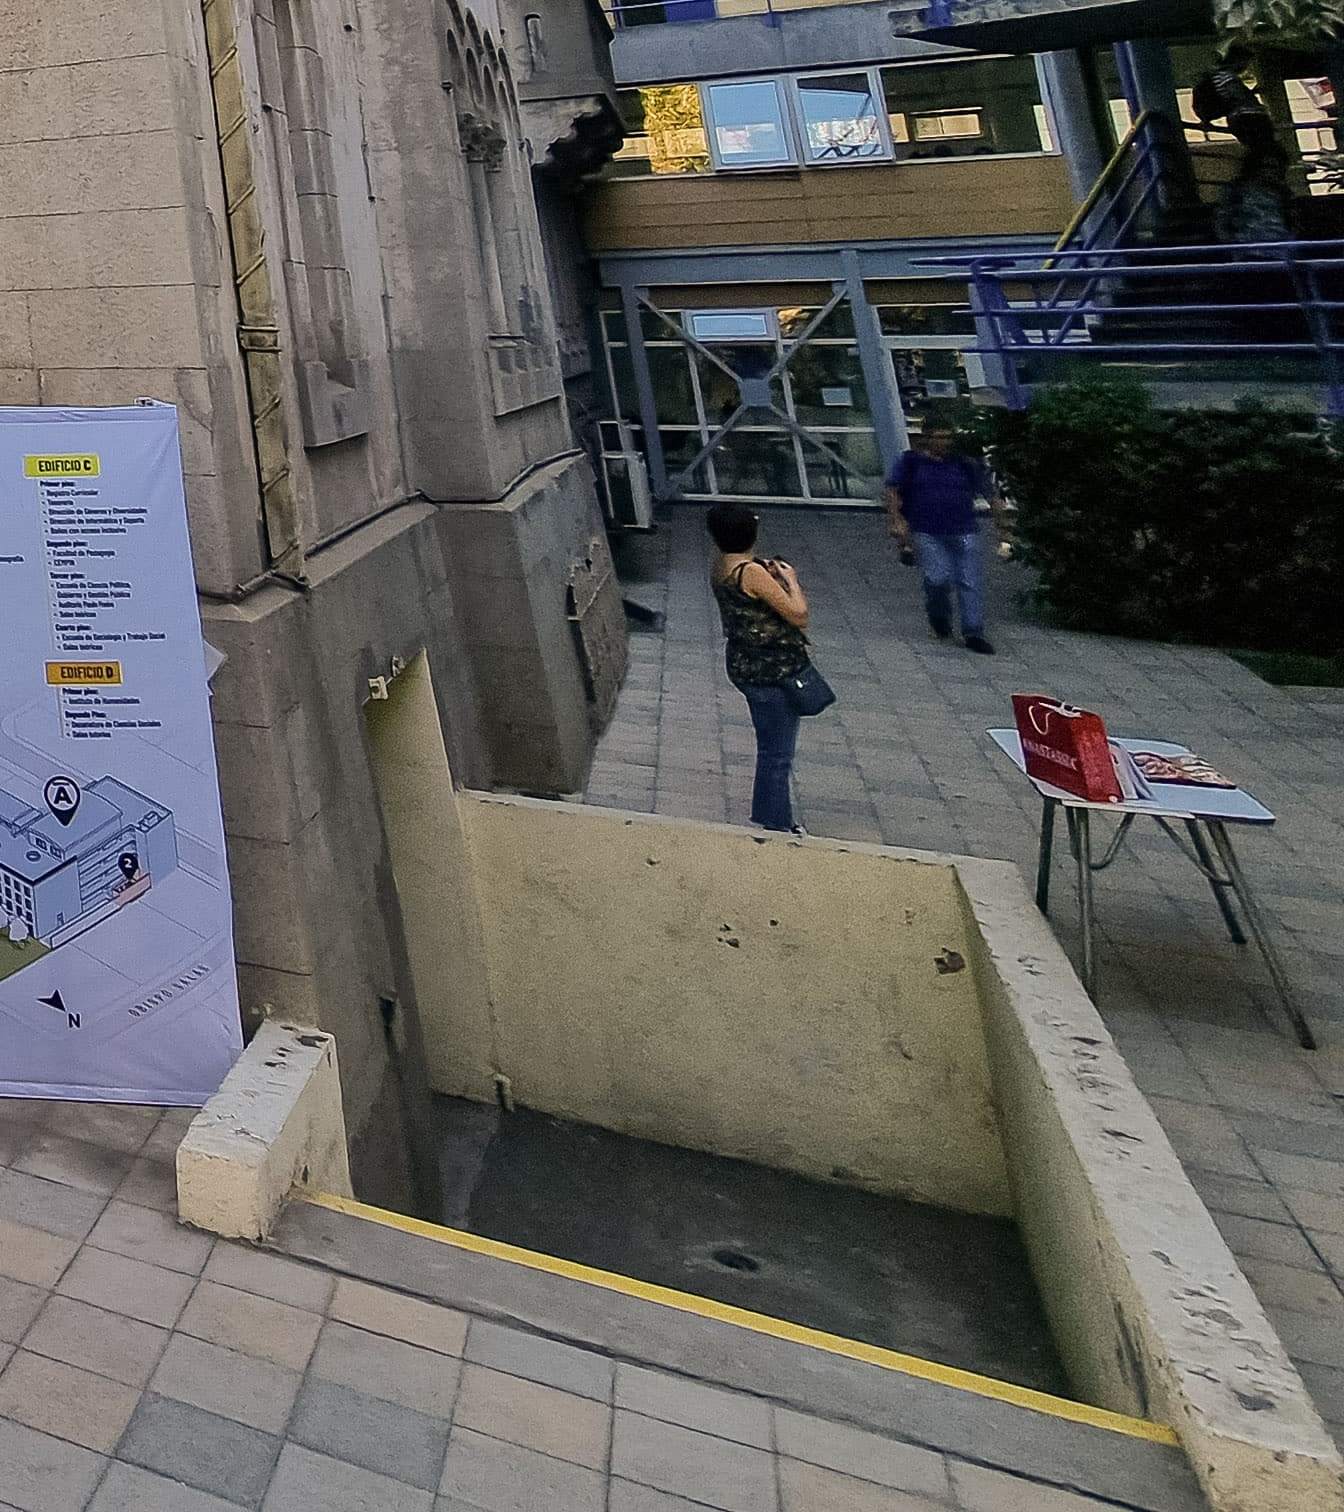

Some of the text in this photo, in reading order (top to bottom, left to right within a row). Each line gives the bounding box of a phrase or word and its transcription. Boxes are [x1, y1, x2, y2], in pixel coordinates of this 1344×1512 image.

[38, 459, 92, 473] EDIFICIO C
[60, 665, 114, 679] EDIFICIO D
[53, 786, 73, 805] A
[123, 858, 133, 868] 2
[67, 1013, 81, 1029] N
